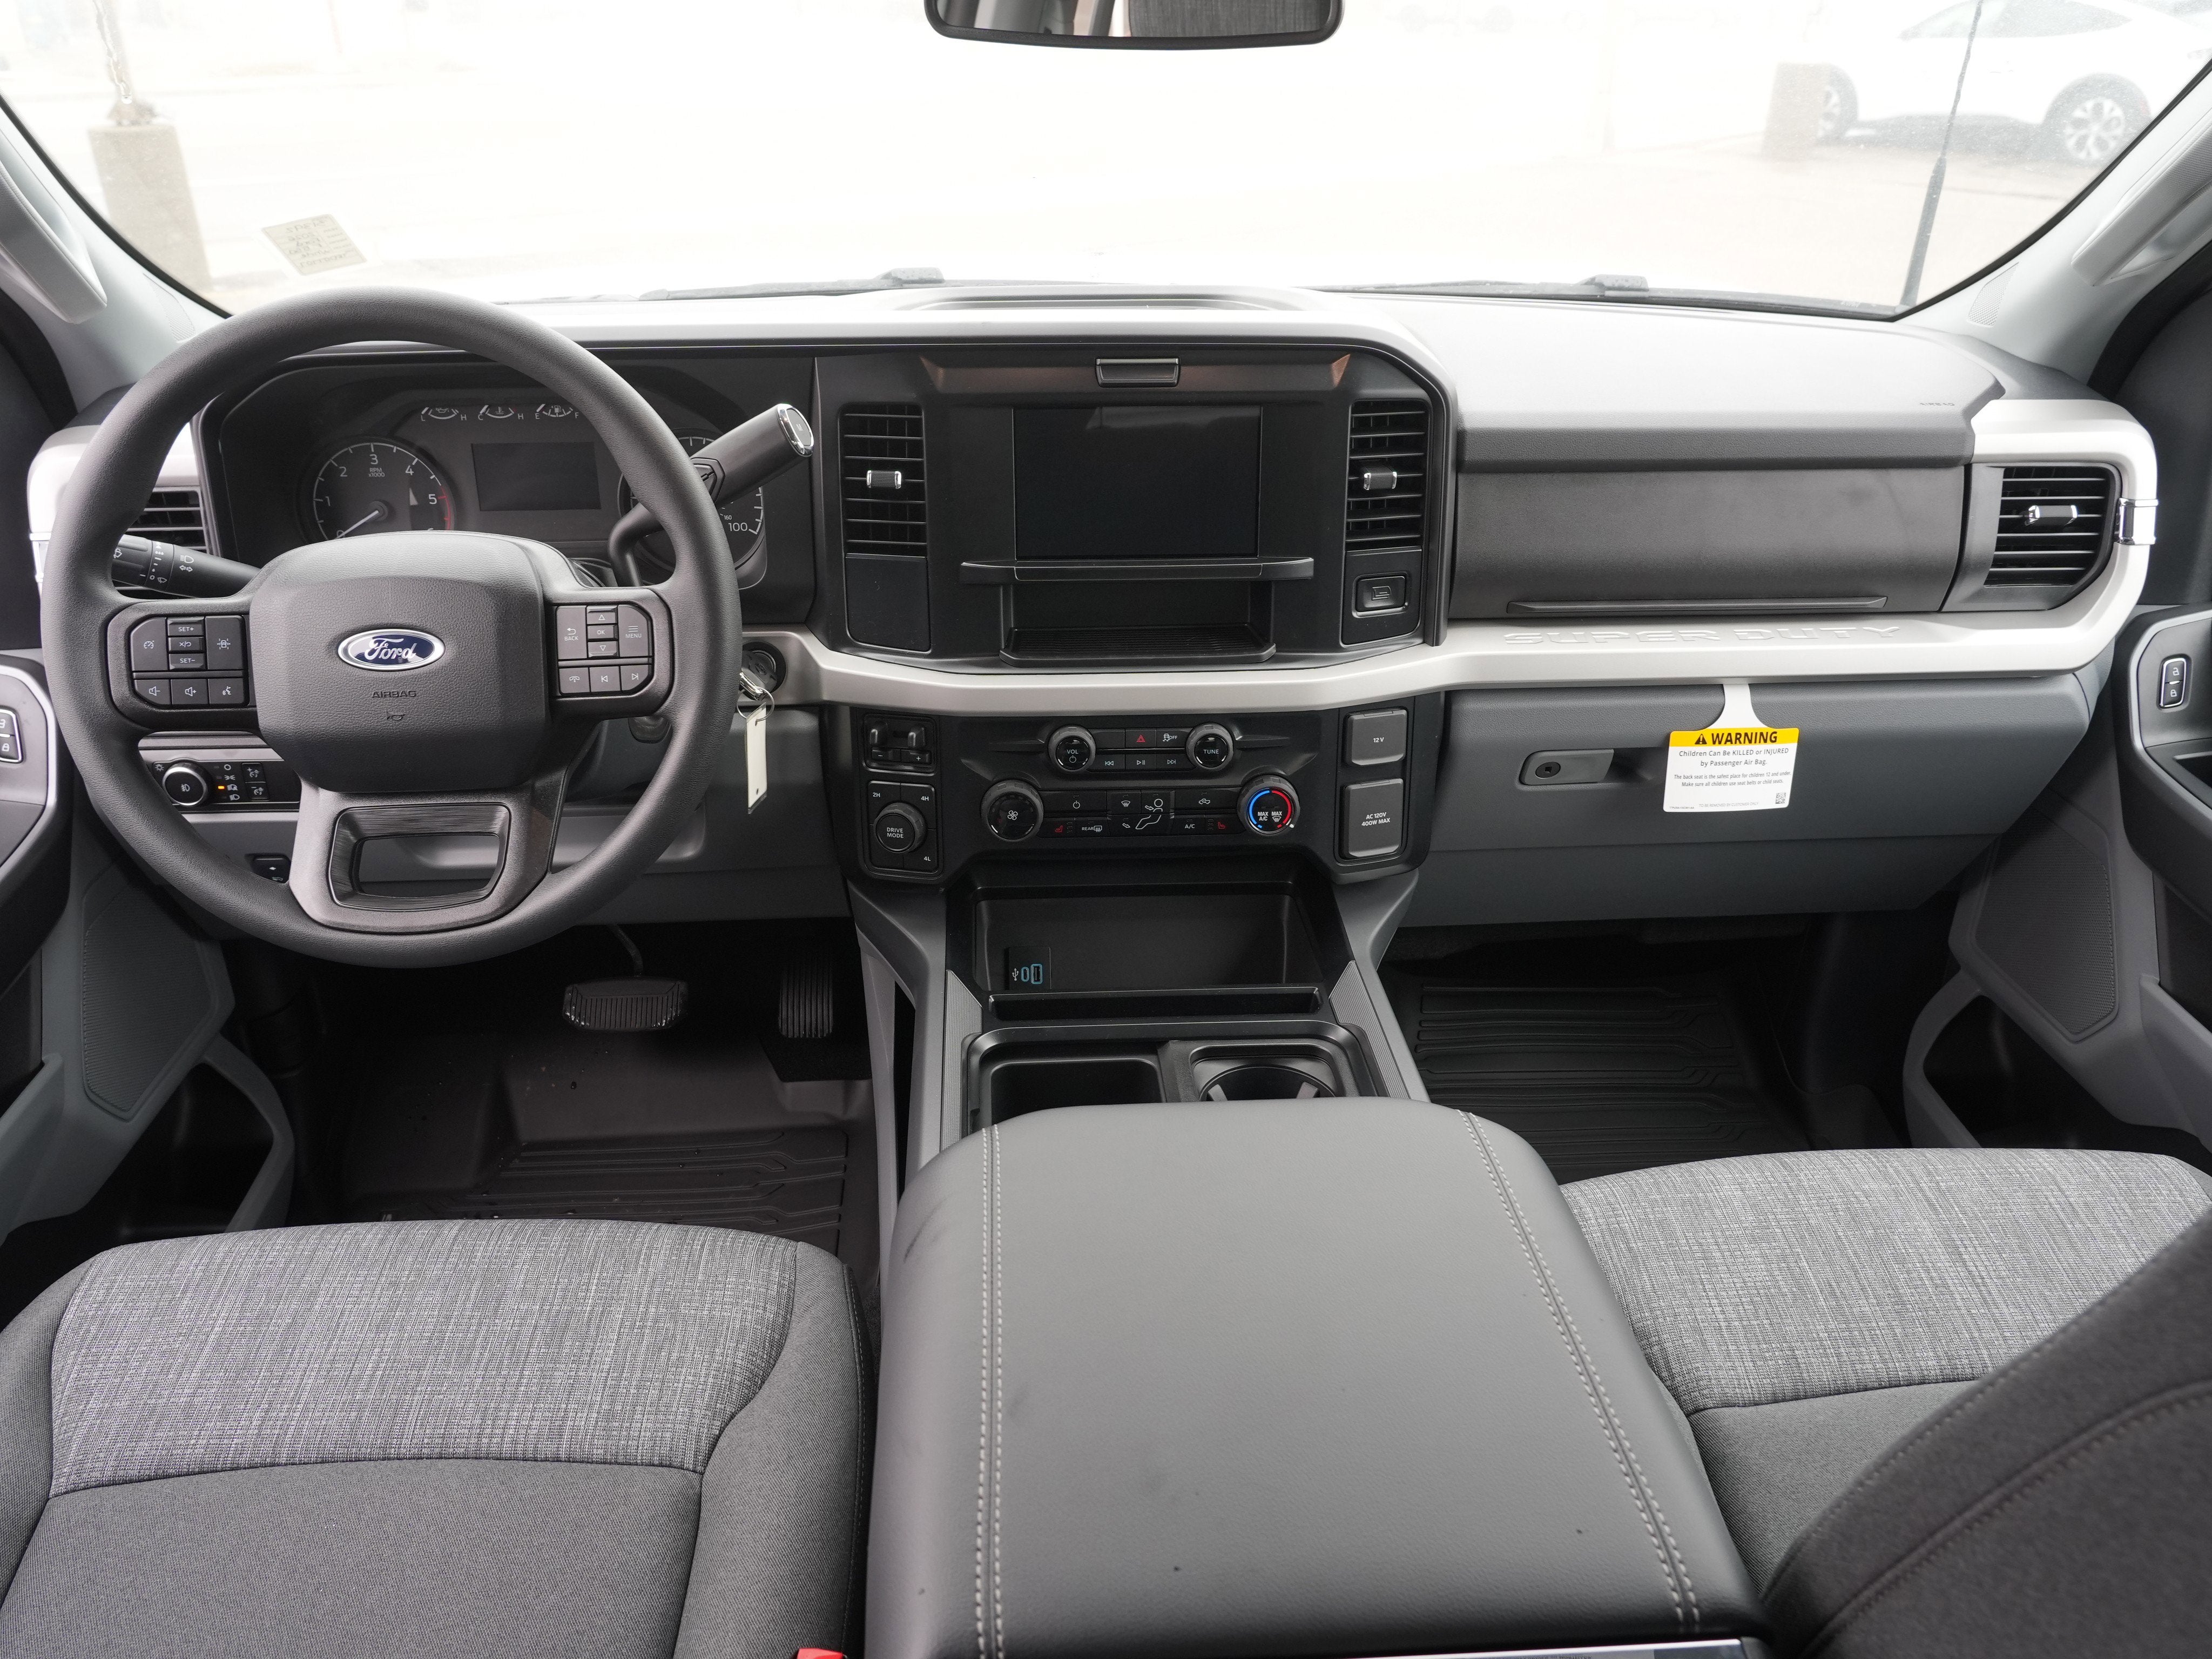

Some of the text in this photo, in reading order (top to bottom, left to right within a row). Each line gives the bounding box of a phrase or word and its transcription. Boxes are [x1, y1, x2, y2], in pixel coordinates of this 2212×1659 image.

[369, 454, 379, 465] 3
[339, 467, 348, 477] 2
[406, 466, 414, 476] 4
[325, 496, 331, 507] 1
[429, 494, 437, 504] 5
[728, 522, 748, 532] 100
[1503, 626, 1901, 644] SUPER DUTY
[364, 638, 417, 660] Ford
[372, 690, 417, 698] AIRBAG
[1711, 731, 1778, 745] WARNING
